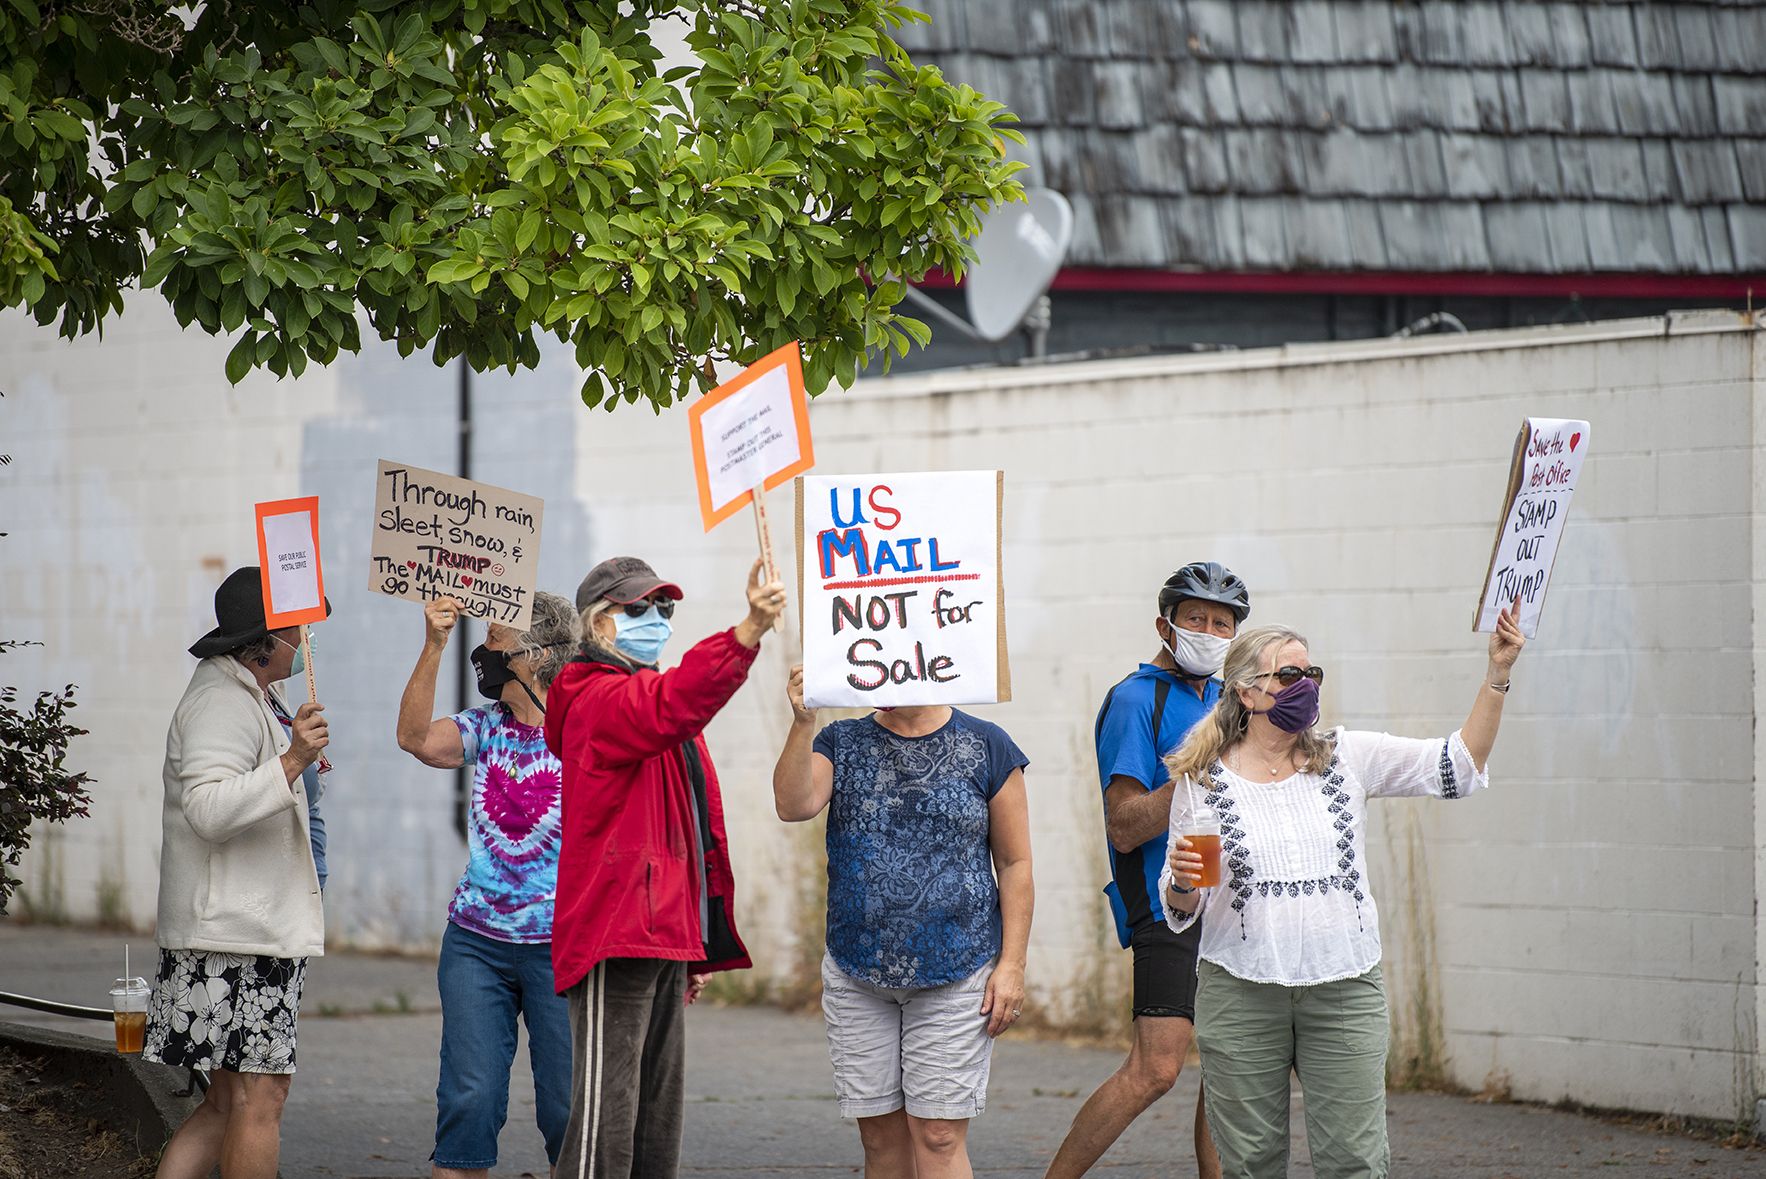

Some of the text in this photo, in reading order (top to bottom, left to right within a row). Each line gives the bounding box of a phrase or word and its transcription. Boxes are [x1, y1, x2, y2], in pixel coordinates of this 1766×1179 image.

[1550, 430, 1564, 456] the
[1545, 460, 1571, 486] Office
[384, 469, 535, 535] Through rain,
[830, 484, 902, 531] US
[1515, 499, 1557, 533] STAMP
[417, 545, 492, 575] TRUMP
[816, 527, 961, 579] MAIL
[1517, 535, 1545, 562] OUT
[373, 556, 526, 602] The MAIL must
[380, 576, 409, 596] go
[1494, 565, 1544, 607] TRUMP
[832, 587, 984, 636] NOT for
[846, 638, 961, 692] Sale
